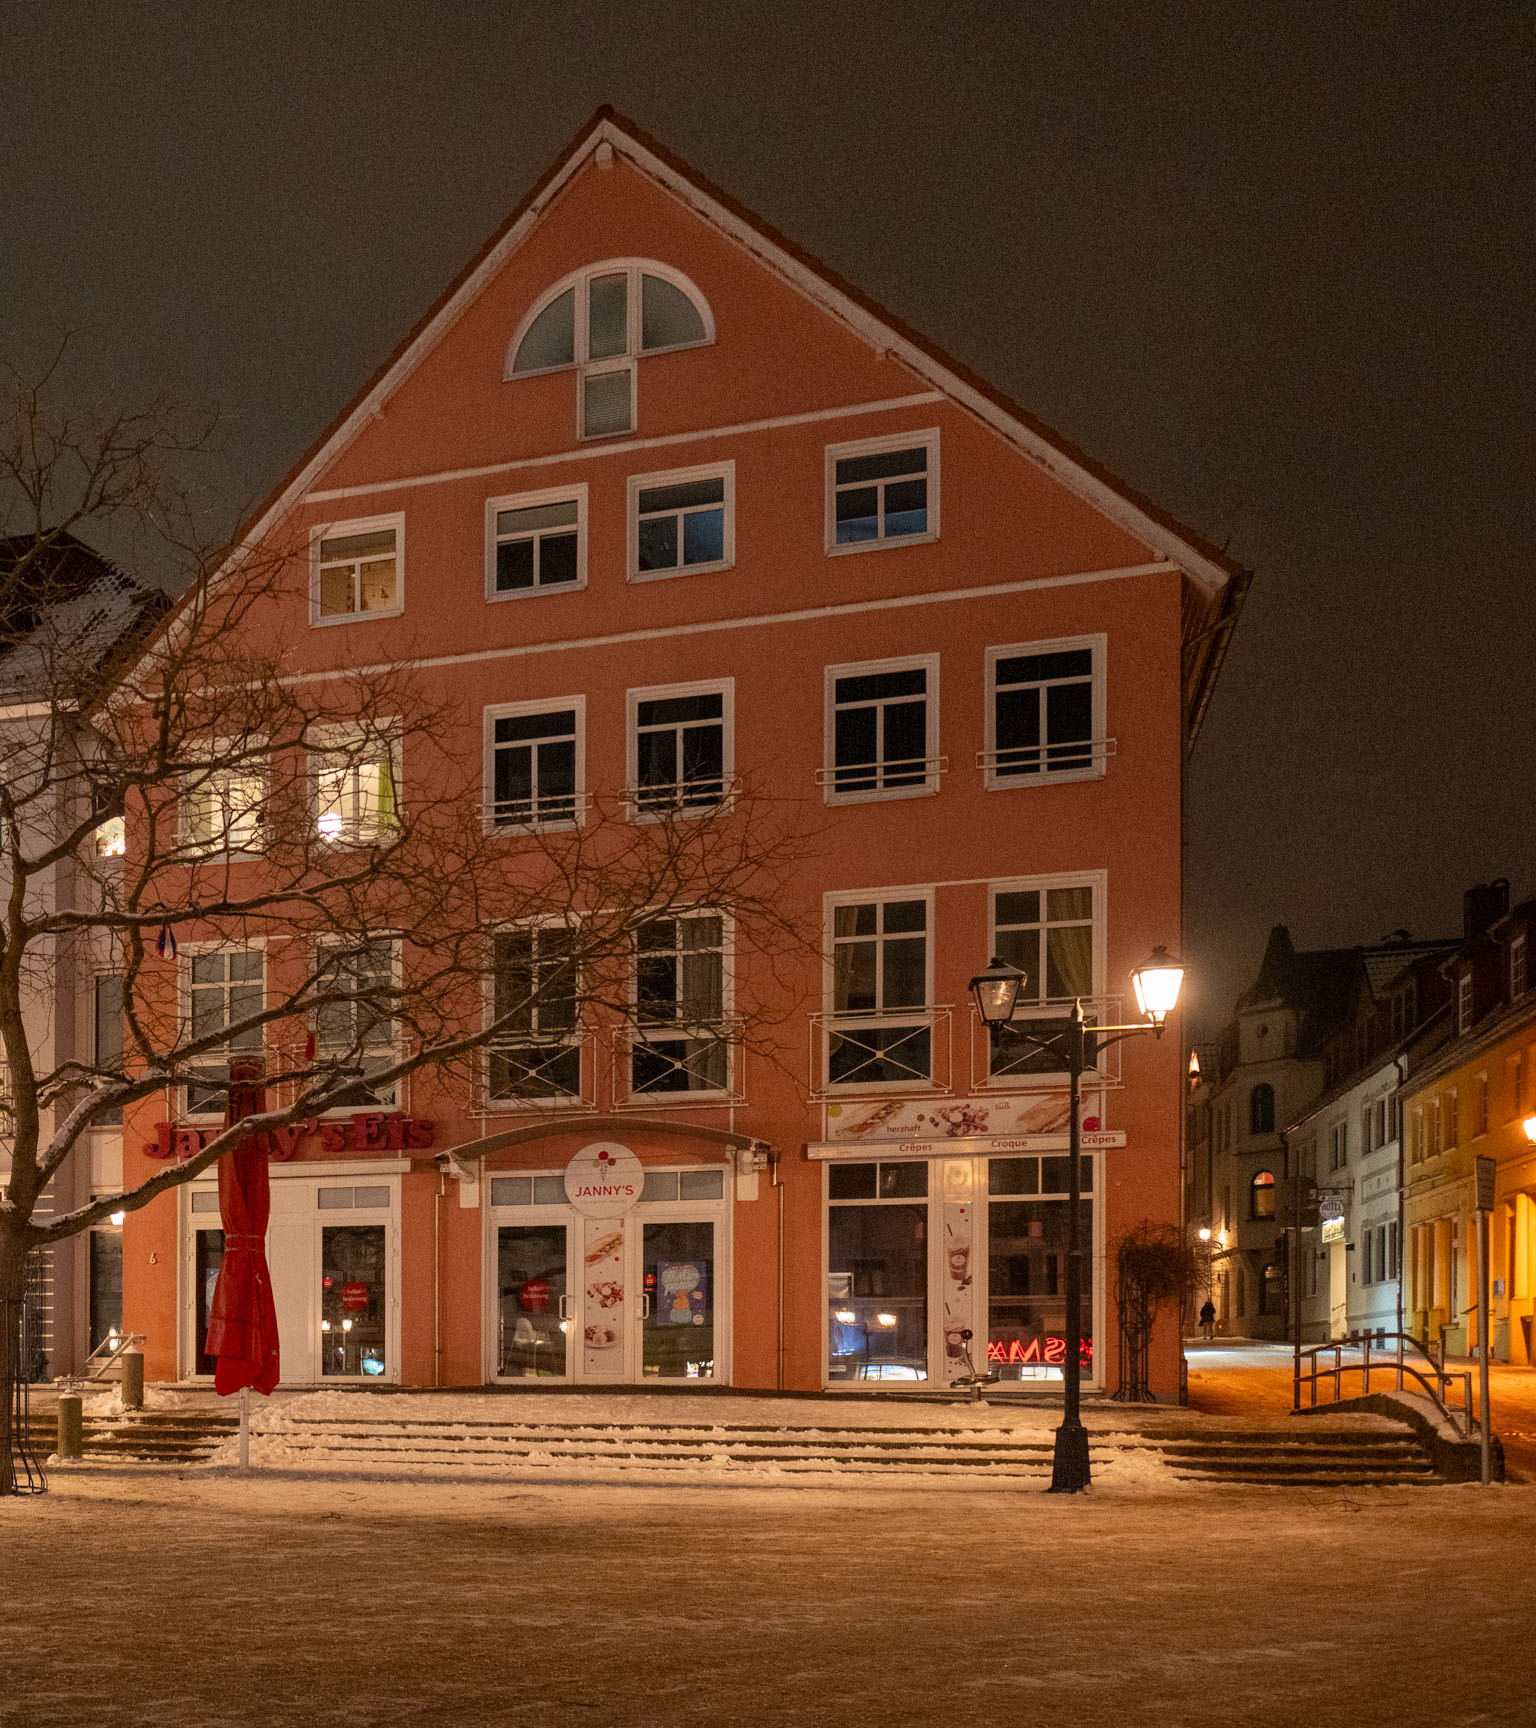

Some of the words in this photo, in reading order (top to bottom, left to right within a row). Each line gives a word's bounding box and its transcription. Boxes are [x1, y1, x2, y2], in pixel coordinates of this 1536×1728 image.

[994, 1102, 1010, 1110] süß
[886, 1124, 921, 1133] herzhaft
[143, 1117, 345, 1161] Jay's
[351, 1111, 435, 1151] Eis
[899, 1142, 933, 1153] Crêpes
[991, 1139, 1027, 1149] Croque
[1081, 1134, 1117, 1145] Crêpes
[575, 1184, 634, 1197] JANNY'S
[1321, 1201, 1342, 1211] HOTEL
[149, 1252, 157, 1264] 6
